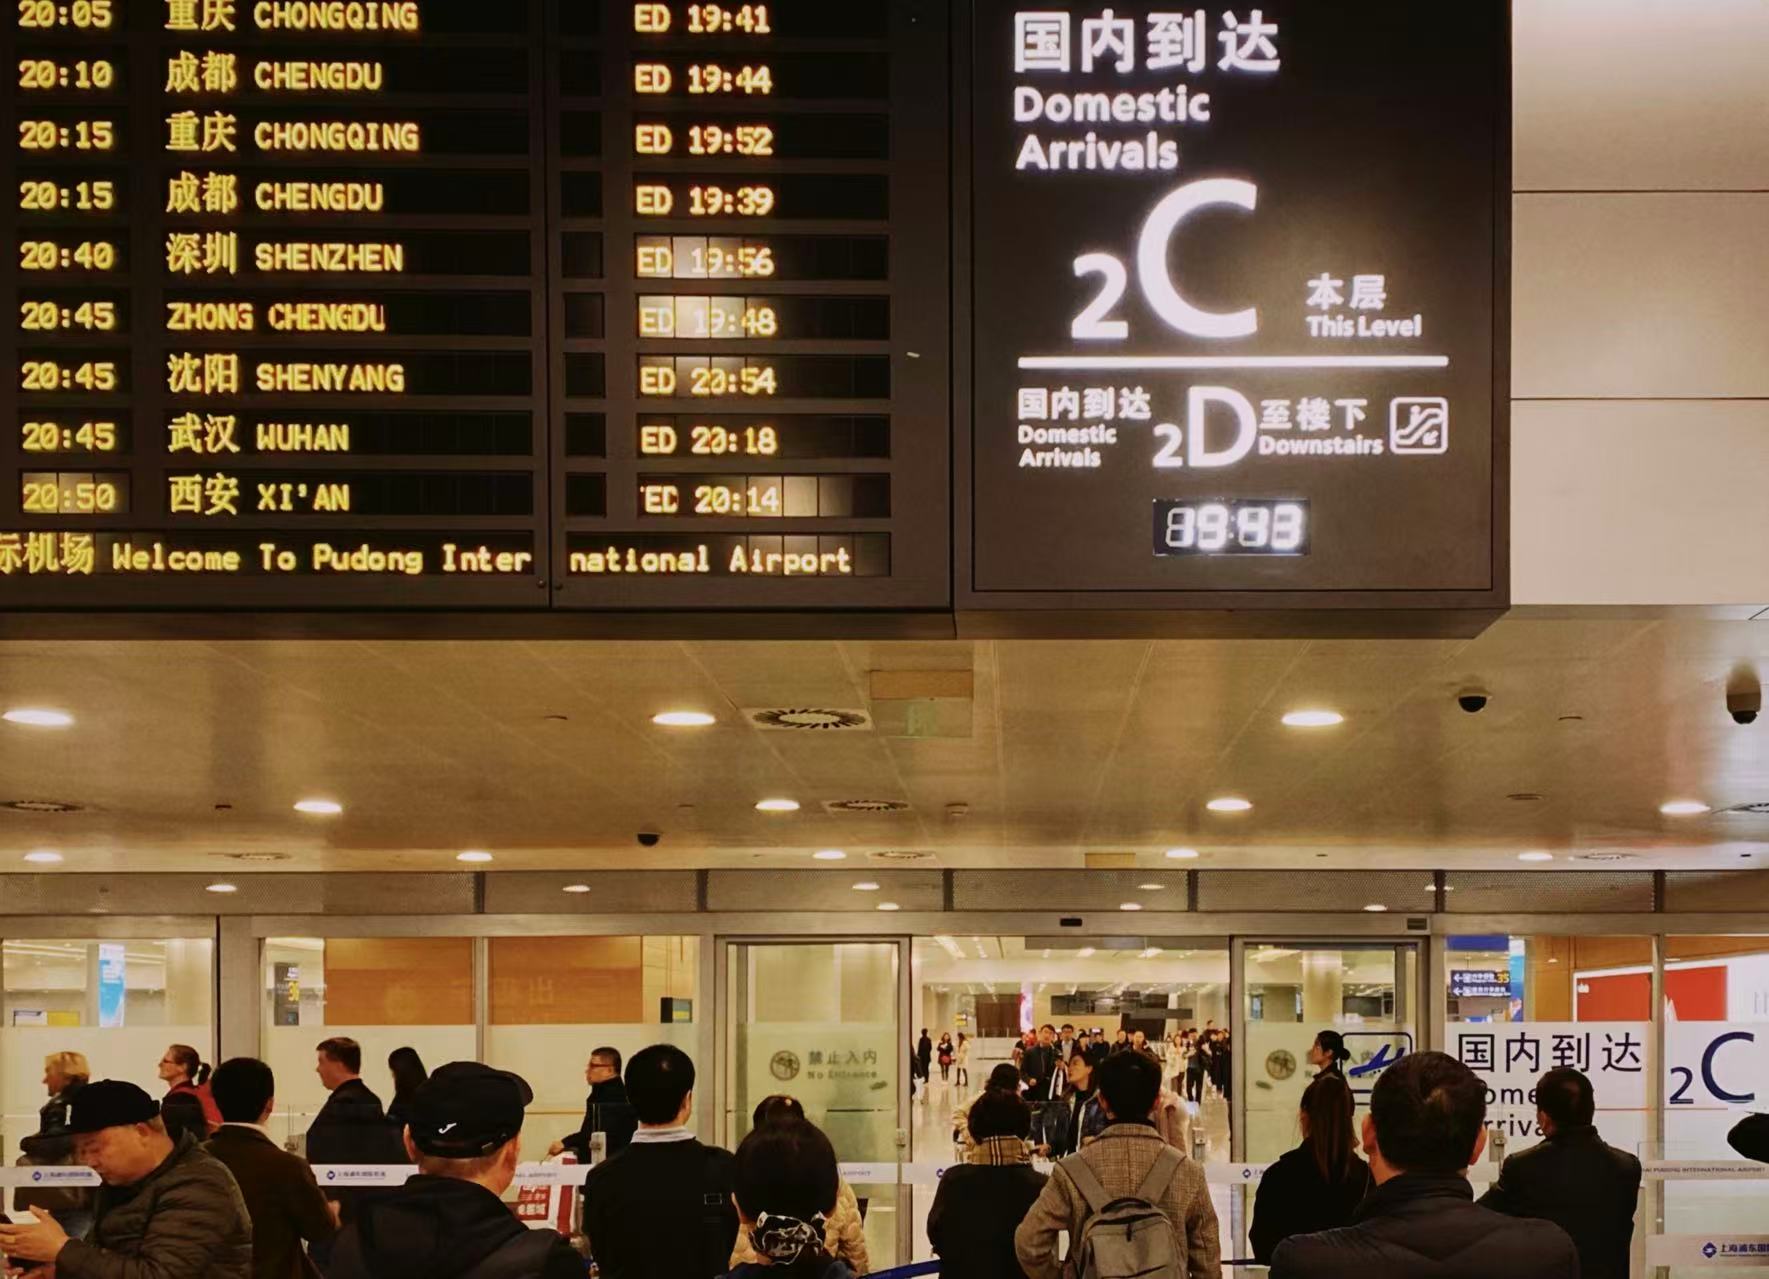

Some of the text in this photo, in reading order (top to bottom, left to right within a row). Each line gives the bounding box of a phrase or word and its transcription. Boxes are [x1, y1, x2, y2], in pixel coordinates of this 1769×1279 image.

[18, 0, 771, 33] 20:05 重庆 CHONGQING ED 19:41
[1014, 9, 1281, 73] 国内到达
[19, 50, 773, 94] 20:10 成都 CHENGDU ED 19:44
[1014, 84, 1210, 122] Domestic
[19, 110, 773, 155] 20:15 重庆 CHONGQING ED 19:52
[1015, 131, 1179, 170] Arrivals
[20, 171, 774, 215] 20:15 成都 CHENGDU ED 19:39
[20, 231, 775, 276] 20:40 深圳 SHENZHEN ED 19:56
[1306, 273, 1387, 310] 本层
[21, 301, 115, 330] 20:45
[166, 303, 254, 331] ZHONG
[640, 307, 674, 334] ED
[693, 307, 777, 336] 19:48
[1305, 314, 1422, 337] This Level
[21, 352, 777, 395] 20:45 沈阳 SHENYANG ED 20:54
[1018, 386, 1152, 420] 国内到达
[1260, 397, 1368, 431] 至楼下
[22, 412, 778, 455] 20:45 武汉 WUHAN ED 20:18
[1017, 423, 1117, 445] Domestic
[1258, 434, 1384, 456] Downstairs
[1018, 447, 1101, 468] Arrivals
[23, 483, 116, 511] 20:50
[168, 472, 240, 515] 西安
[257, 483, 350, 511] XI'AN
[694, 485, 780, 514] 20:14
[112, 543, 241, 571] Welcome
[259, 543, 297, 571] To
[313, 543, 423, 575] Pudong
[442, 543, 532, 571] Inter
[570, 544, 711, 572] national
[729, 544, 851, 575] Airport
[1458, 1031, 1642, 1073] 国内到达
